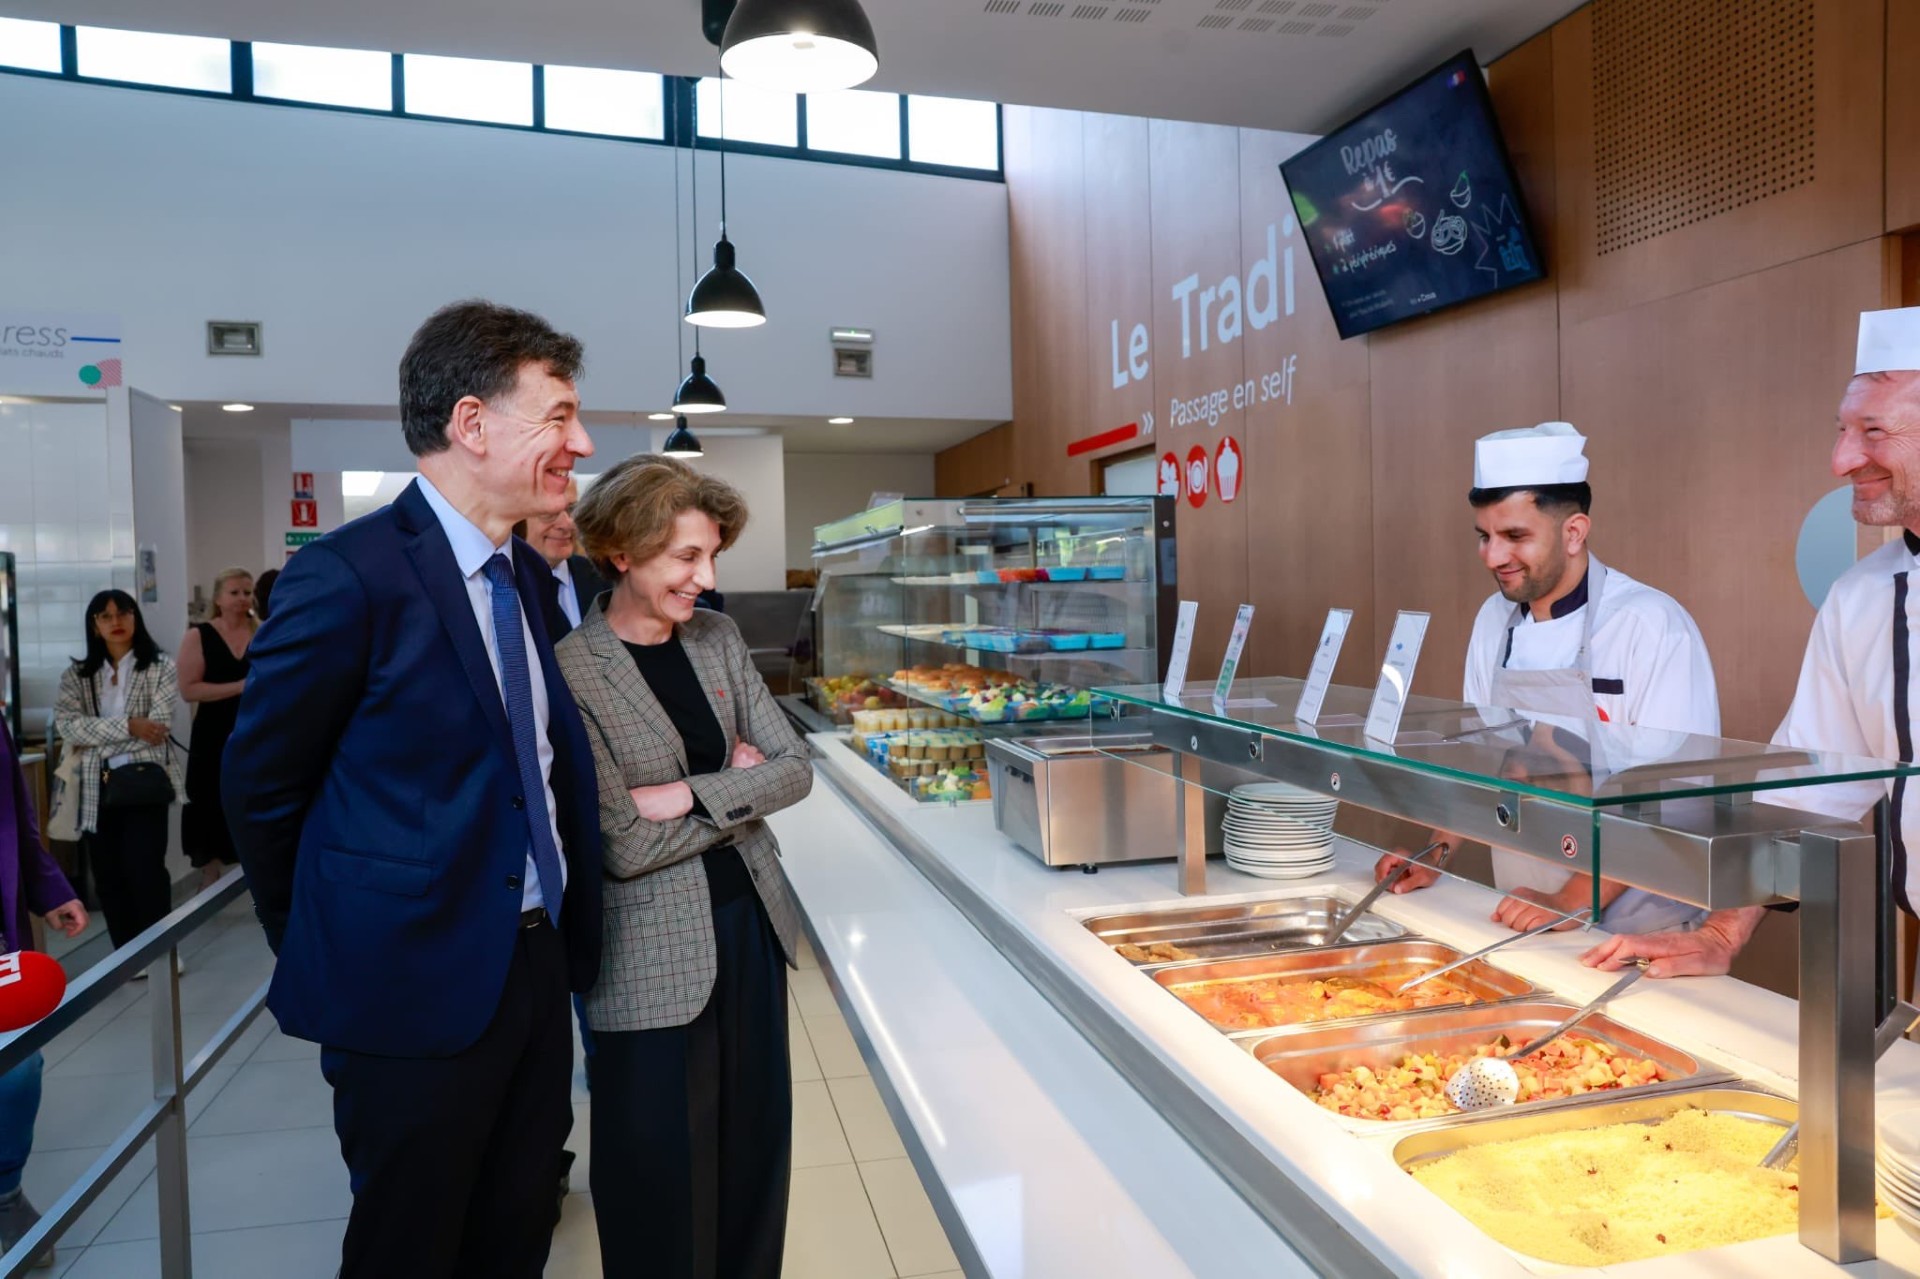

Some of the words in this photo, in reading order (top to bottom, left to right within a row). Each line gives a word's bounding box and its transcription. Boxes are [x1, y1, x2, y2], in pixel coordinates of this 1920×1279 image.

[1340, 128, 1397, 175] Repas
[1111, 319, 1149, 389] Le
[1172, 213, 1295, 359] Tradi
[1170, 388, 1229, 428] Passage
[1233, 379, 1255, 409] en
[1261, 354, 1297, 406] self
